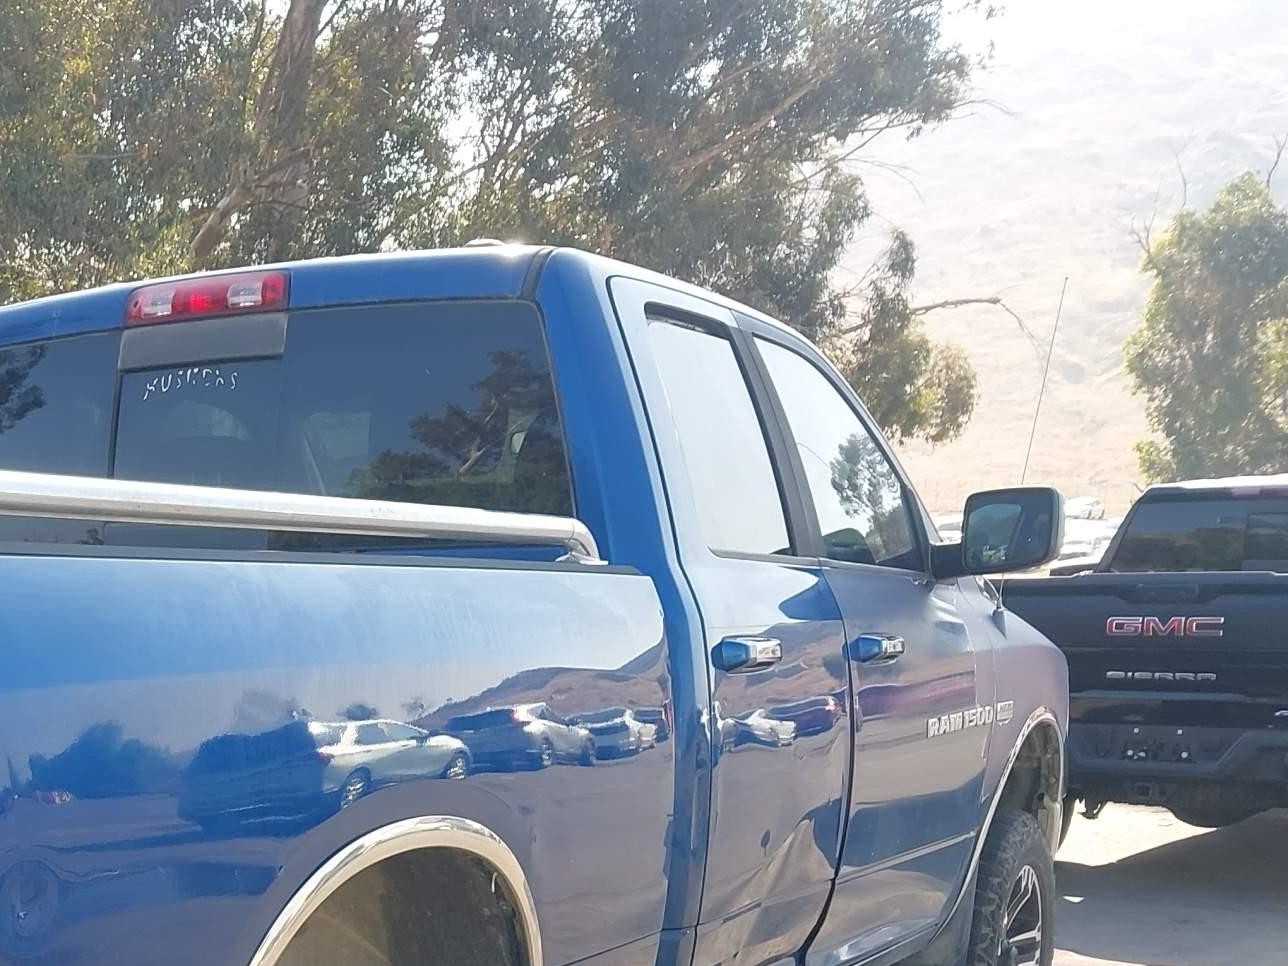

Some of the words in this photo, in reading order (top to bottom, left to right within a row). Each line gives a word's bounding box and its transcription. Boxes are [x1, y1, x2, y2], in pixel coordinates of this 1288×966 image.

[1106, 616, 1225, 637] GMC
[1105, 670, 1217, 681] SIERRA
[926, 711, 963, 738] RAM
